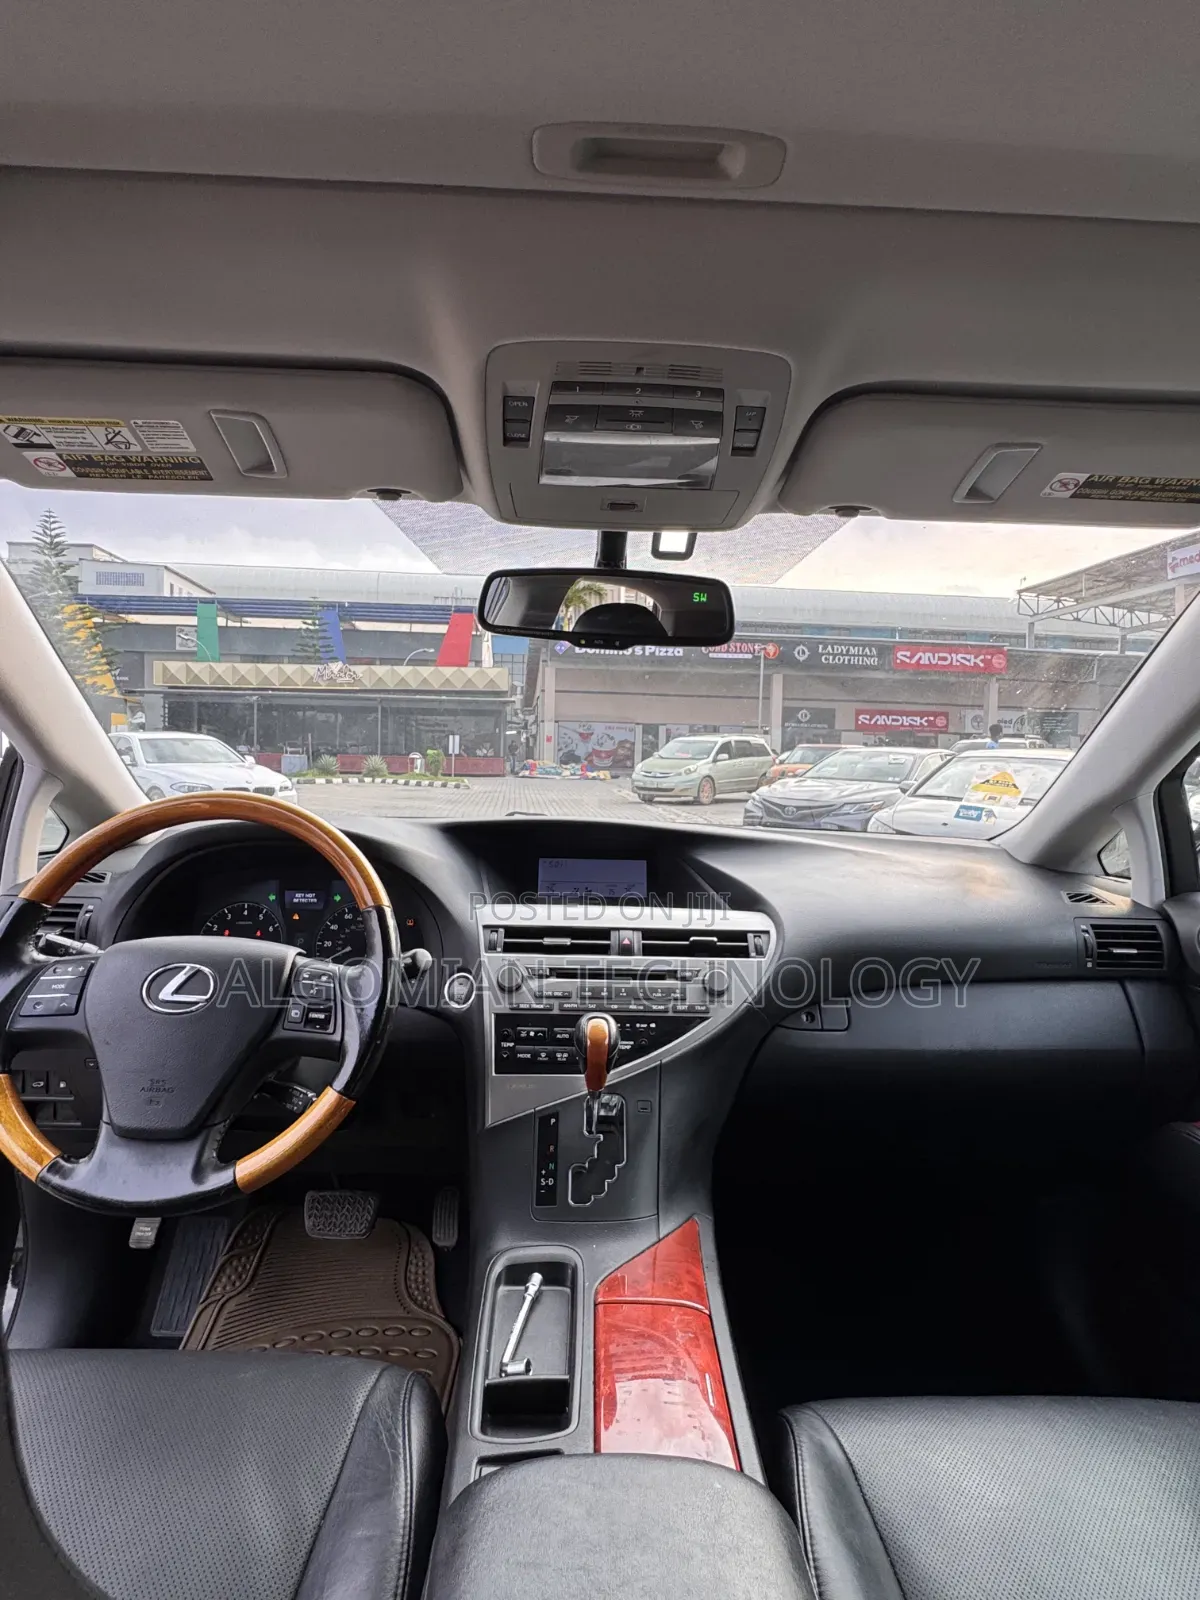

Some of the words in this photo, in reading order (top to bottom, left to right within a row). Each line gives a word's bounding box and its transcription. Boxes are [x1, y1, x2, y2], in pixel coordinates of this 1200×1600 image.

[62, 453, 88, 461] AIR
[93, 455, 127, 463] BAG
[128, 456, 202, 464] WARNING
[1087, 475, 1116, 483] AIR
[1118, 476, 1150, 484] BAG
[692, 592, 707, 602] SW
[645, 645, 684, 656] Pizza
[729, 642, 762, 656] STONE
[818, 644, 877, 656] LADYMIAN
[821, 655, 879, 666] CLOTHING
[896, 650, 985, 667] SANDISK
[857, 714, 929, 727] SANDISK
[258, 913, 264, 921] 5
[139, 1086, 175, 1094] AIRBAG
[550, 1118, 556, 1126] P
[549, 1162, 555, 1170] N
